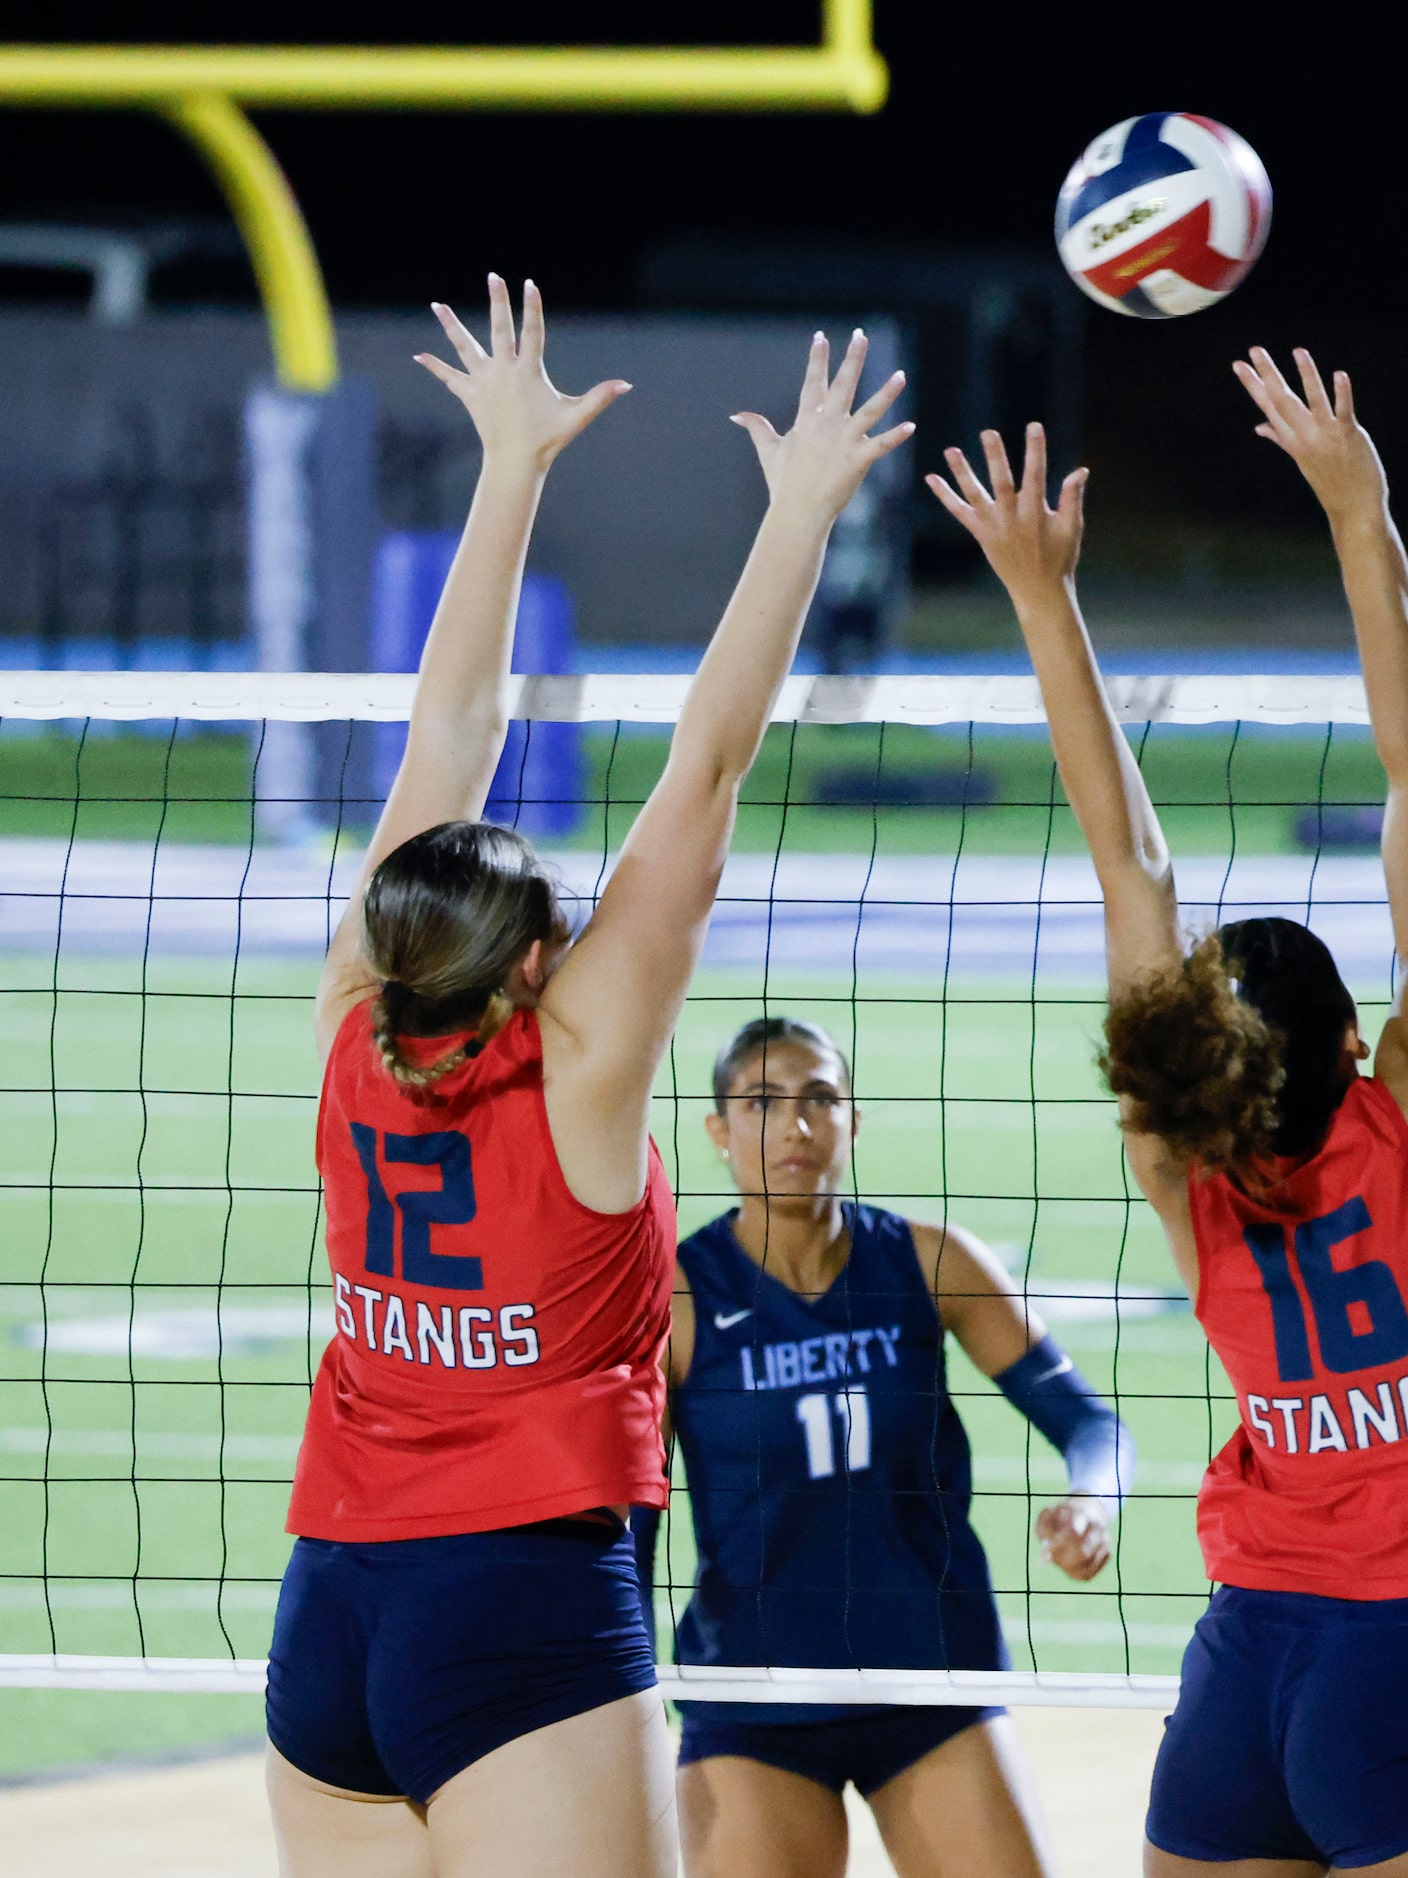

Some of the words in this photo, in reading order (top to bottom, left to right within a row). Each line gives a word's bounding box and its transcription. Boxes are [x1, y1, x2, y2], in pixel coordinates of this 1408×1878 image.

[350, 1121, 484, 1291] 12
[335, 1272, 540, 1369] STANGS
[740, 1325, 901, 1391] LIBERTY
[796, 1383, 872, 1480] 11
